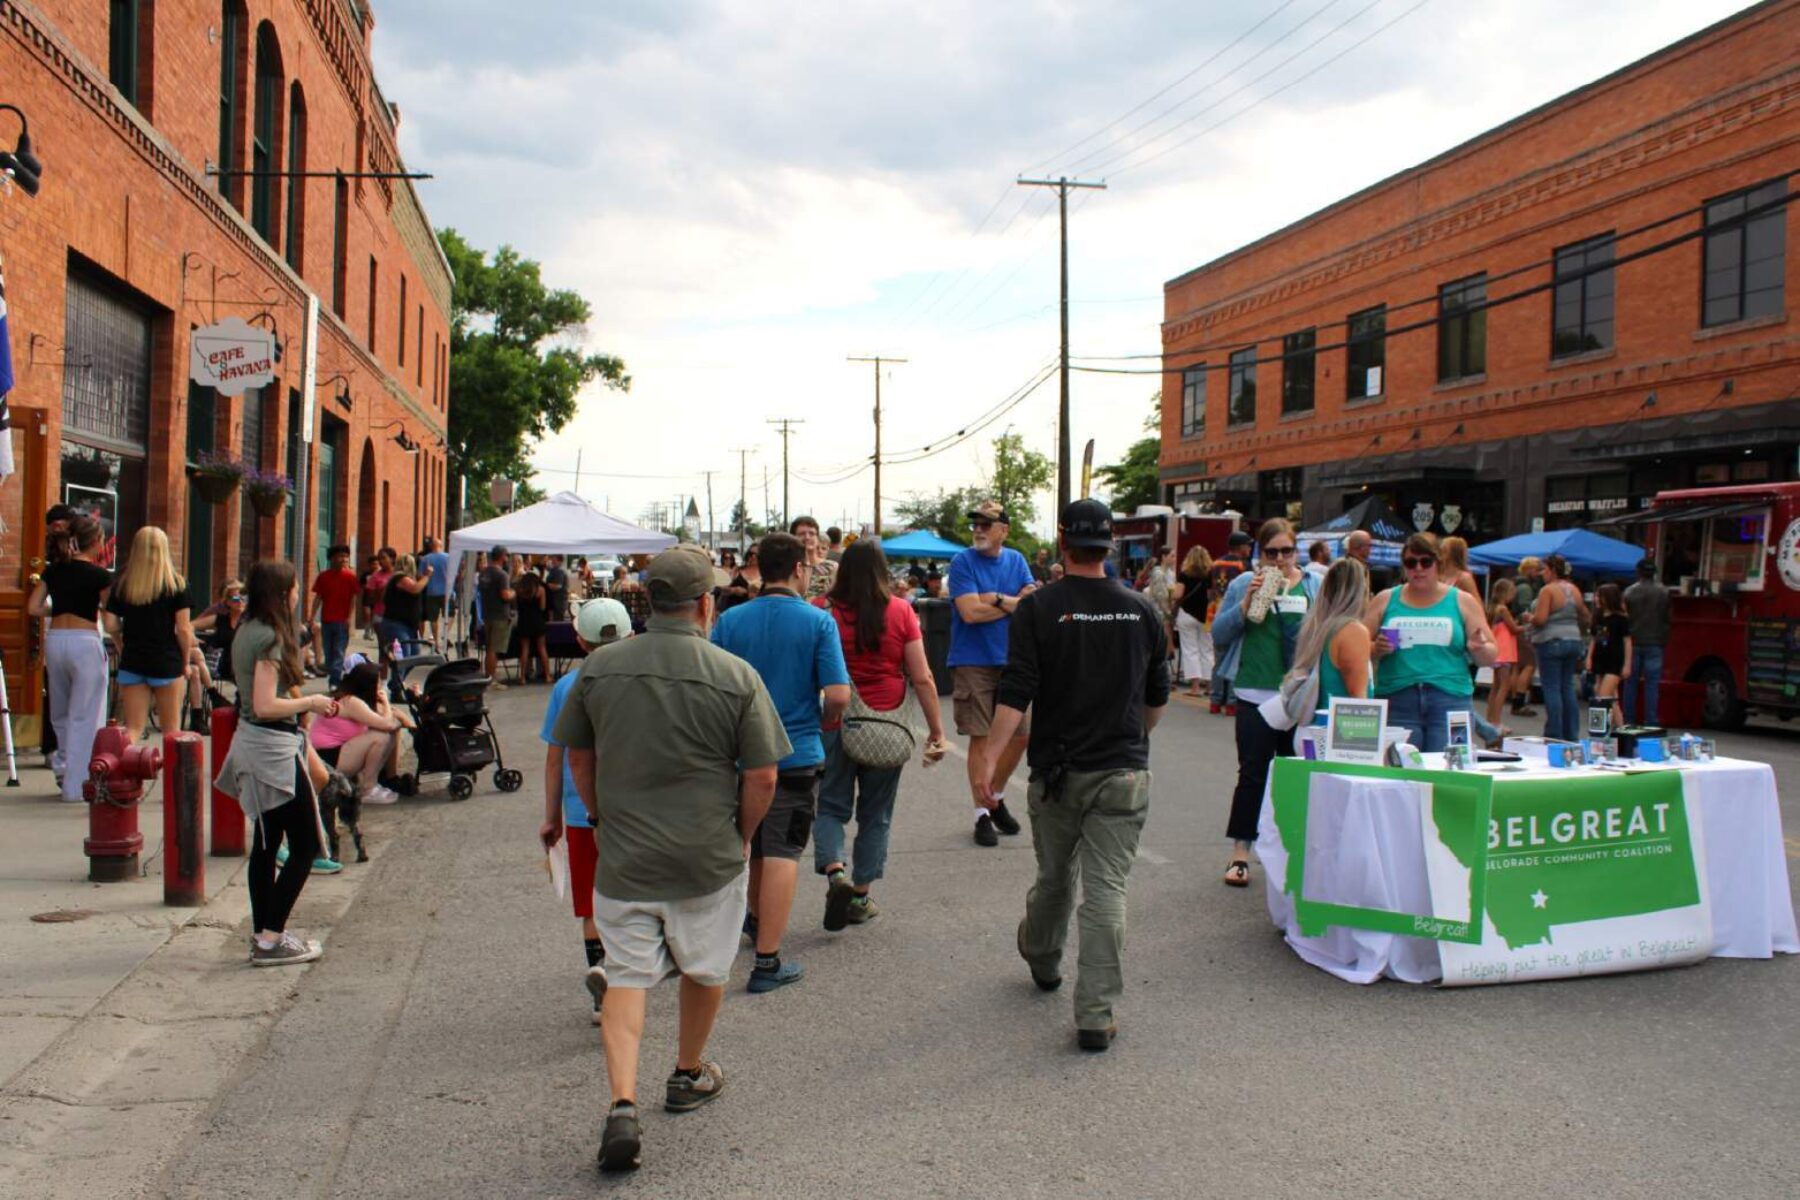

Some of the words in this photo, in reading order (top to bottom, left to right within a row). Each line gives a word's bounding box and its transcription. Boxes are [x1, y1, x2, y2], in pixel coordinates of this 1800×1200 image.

[209, 347, 245, 365] CAFE
[1072, 613, 1114, 622] DEMAND
[1115, 613, 1141, 622] EASY
[1487, 803, 1670, 849] BELGREAT
[1544, 850, 1609, 865] COMMUNITY
[1614, 845, 1673, 858] COALITION
